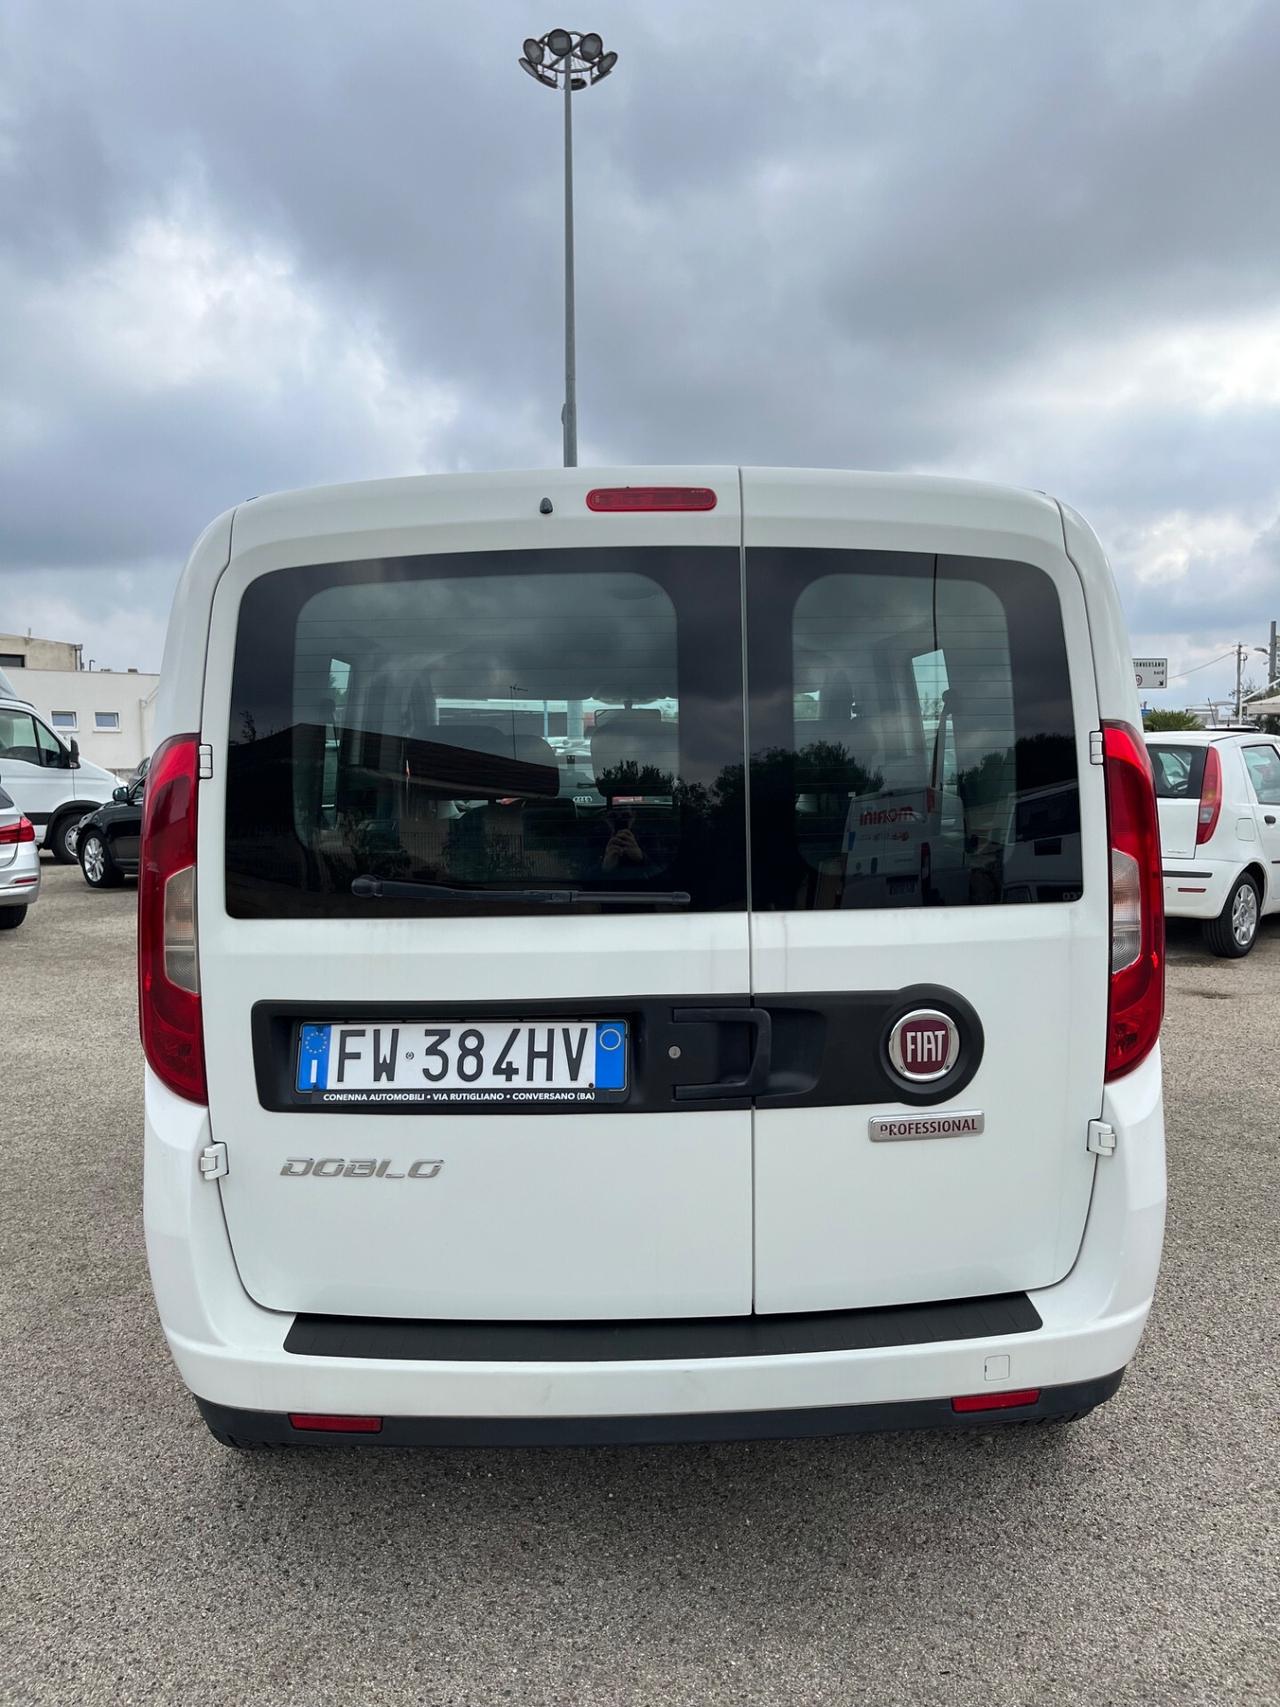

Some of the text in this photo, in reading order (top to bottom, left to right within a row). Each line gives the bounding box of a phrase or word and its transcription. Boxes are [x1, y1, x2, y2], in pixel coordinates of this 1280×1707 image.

[336, 1028, 589, 1083] FW 384HV
[906, 1030, 946, 1063] FIAT
[323, 1093, 368, 1101] CONENNA
[369, 1093, 425, 1101] AUTOMOBILI
[450, 1092, 504, 1100] RUTIGLIANO
[512, 1092, 575, 1100] CONVERSANO
[577, 1092, 595, 1101] (BA)
[880, 1118, 977, 1136] PROFESSIONAL
